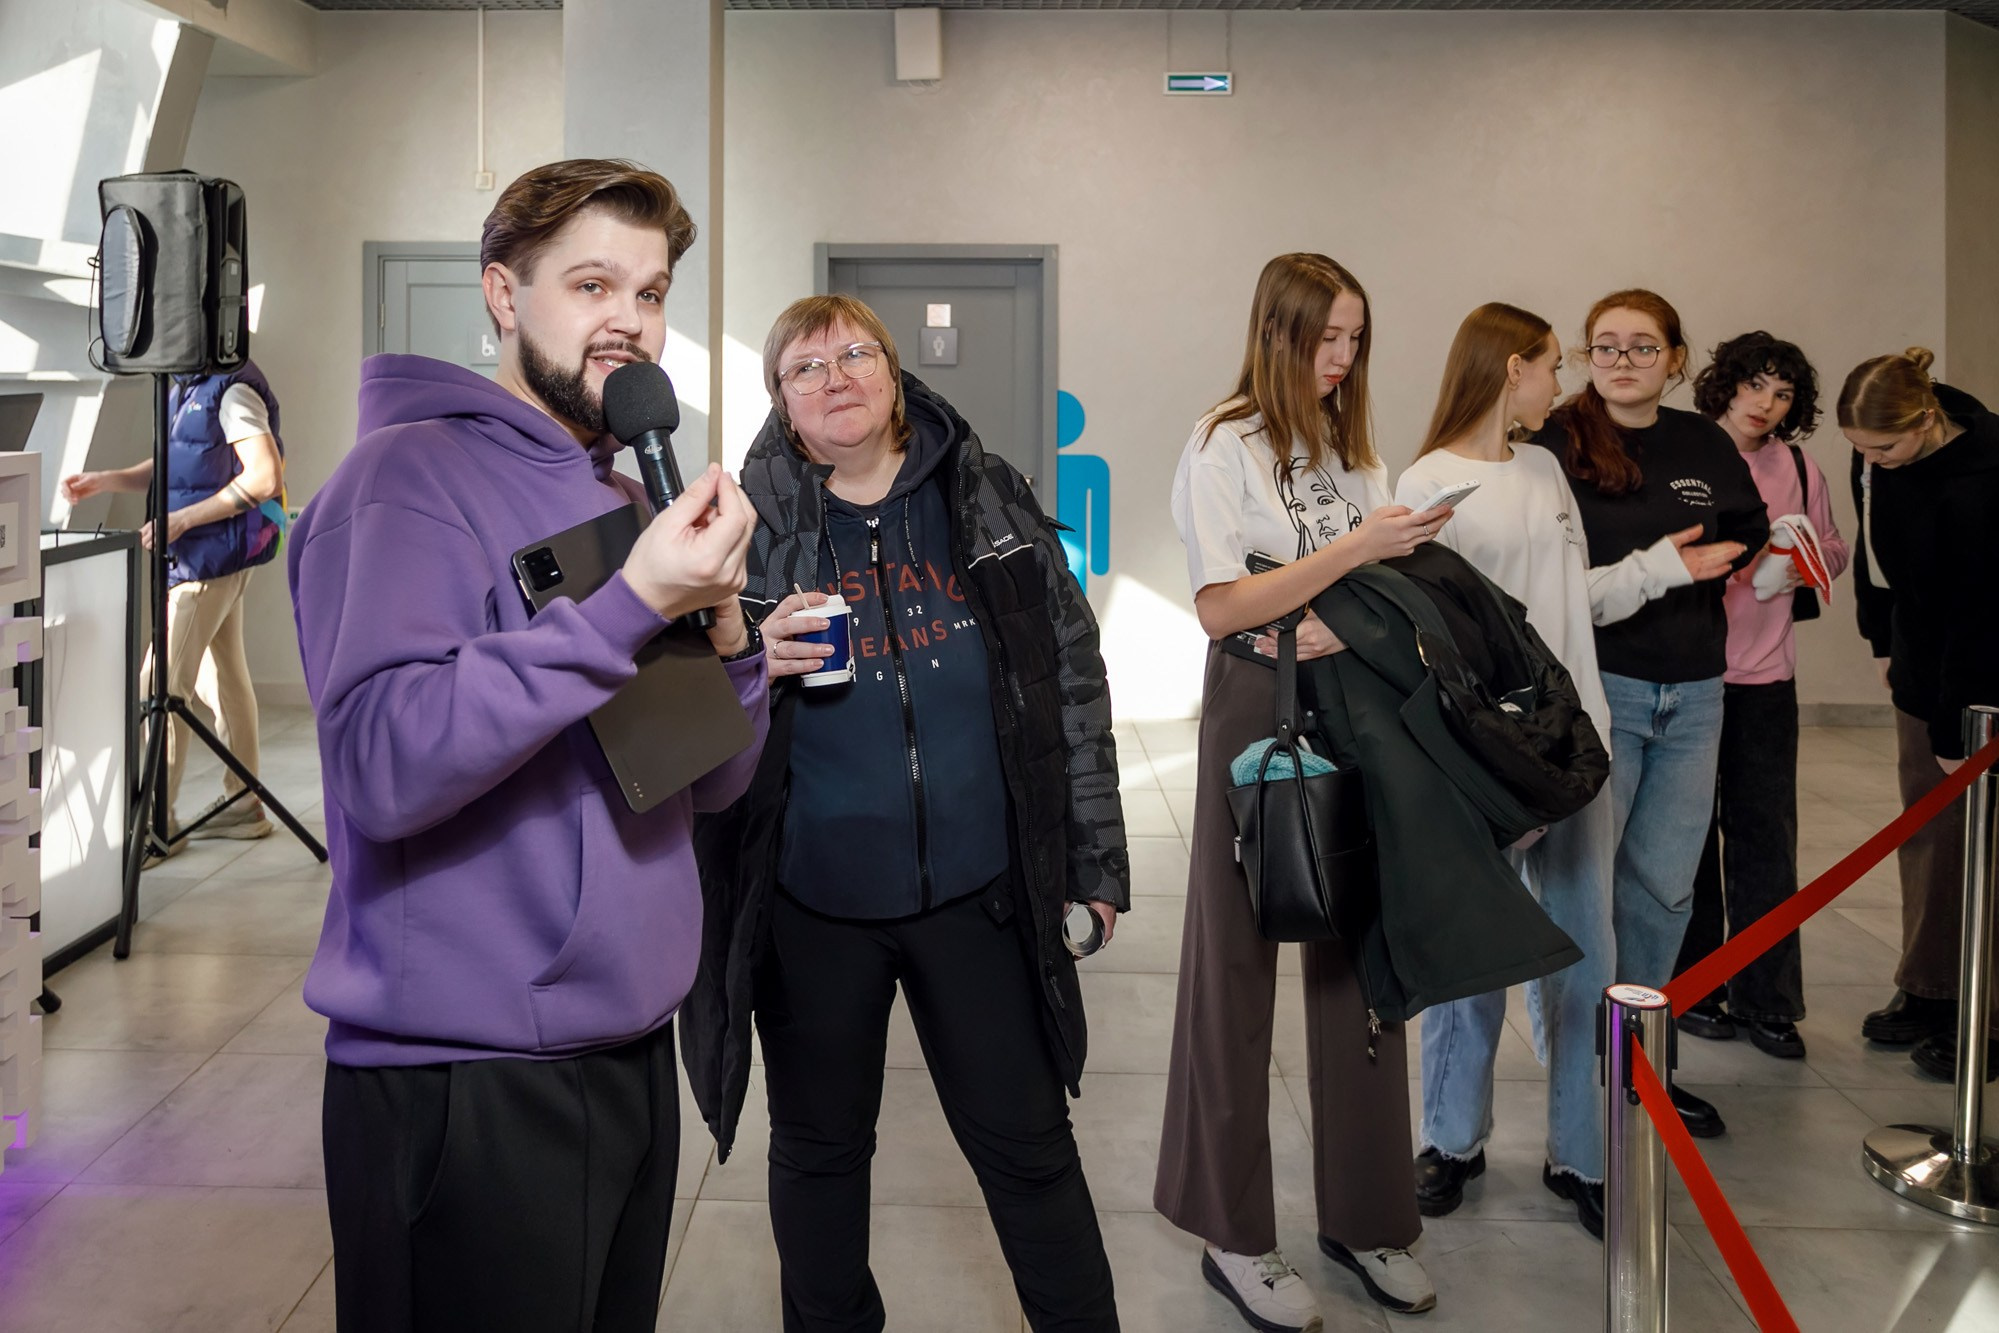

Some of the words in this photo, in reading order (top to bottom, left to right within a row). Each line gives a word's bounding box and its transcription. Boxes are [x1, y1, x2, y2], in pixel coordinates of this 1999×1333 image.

[1669, 478, 1712, 495] ESSENTIAL
[992, 533, 1014, 548] SADE
[906, 605, 923, 617] 32
[953, 618, 976, 630] MRK
